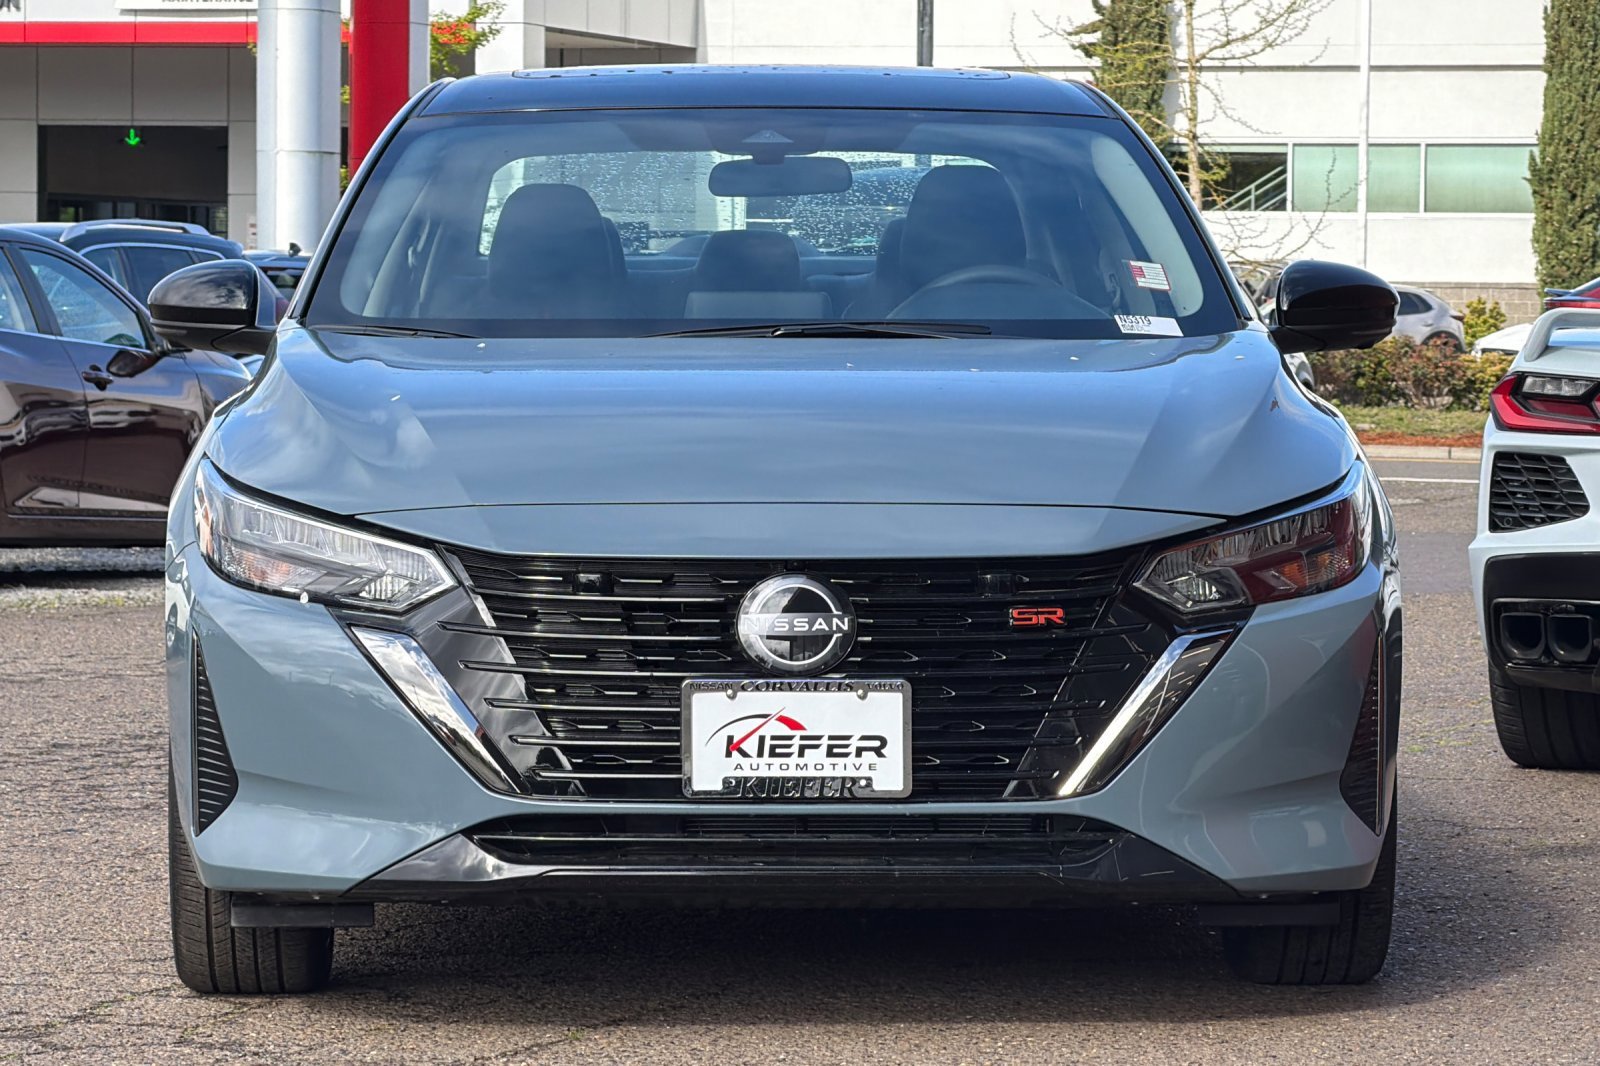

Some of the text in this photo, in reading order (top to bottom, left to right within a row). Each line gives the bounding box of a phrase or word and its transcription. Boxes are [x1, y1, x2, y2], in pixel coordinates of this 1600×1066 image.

[744, 617, 849, 631] NISSAN
[1010, 607, 1065, 625] SR
[689, 680, 904, 691] NISSAN CORVALLIS VOLVO
[725, 735, 888, 758] KIEFER
[733, 763, 877, 771] AUTOMOTIVE
[738, 777, 858, 797] KIEFER
